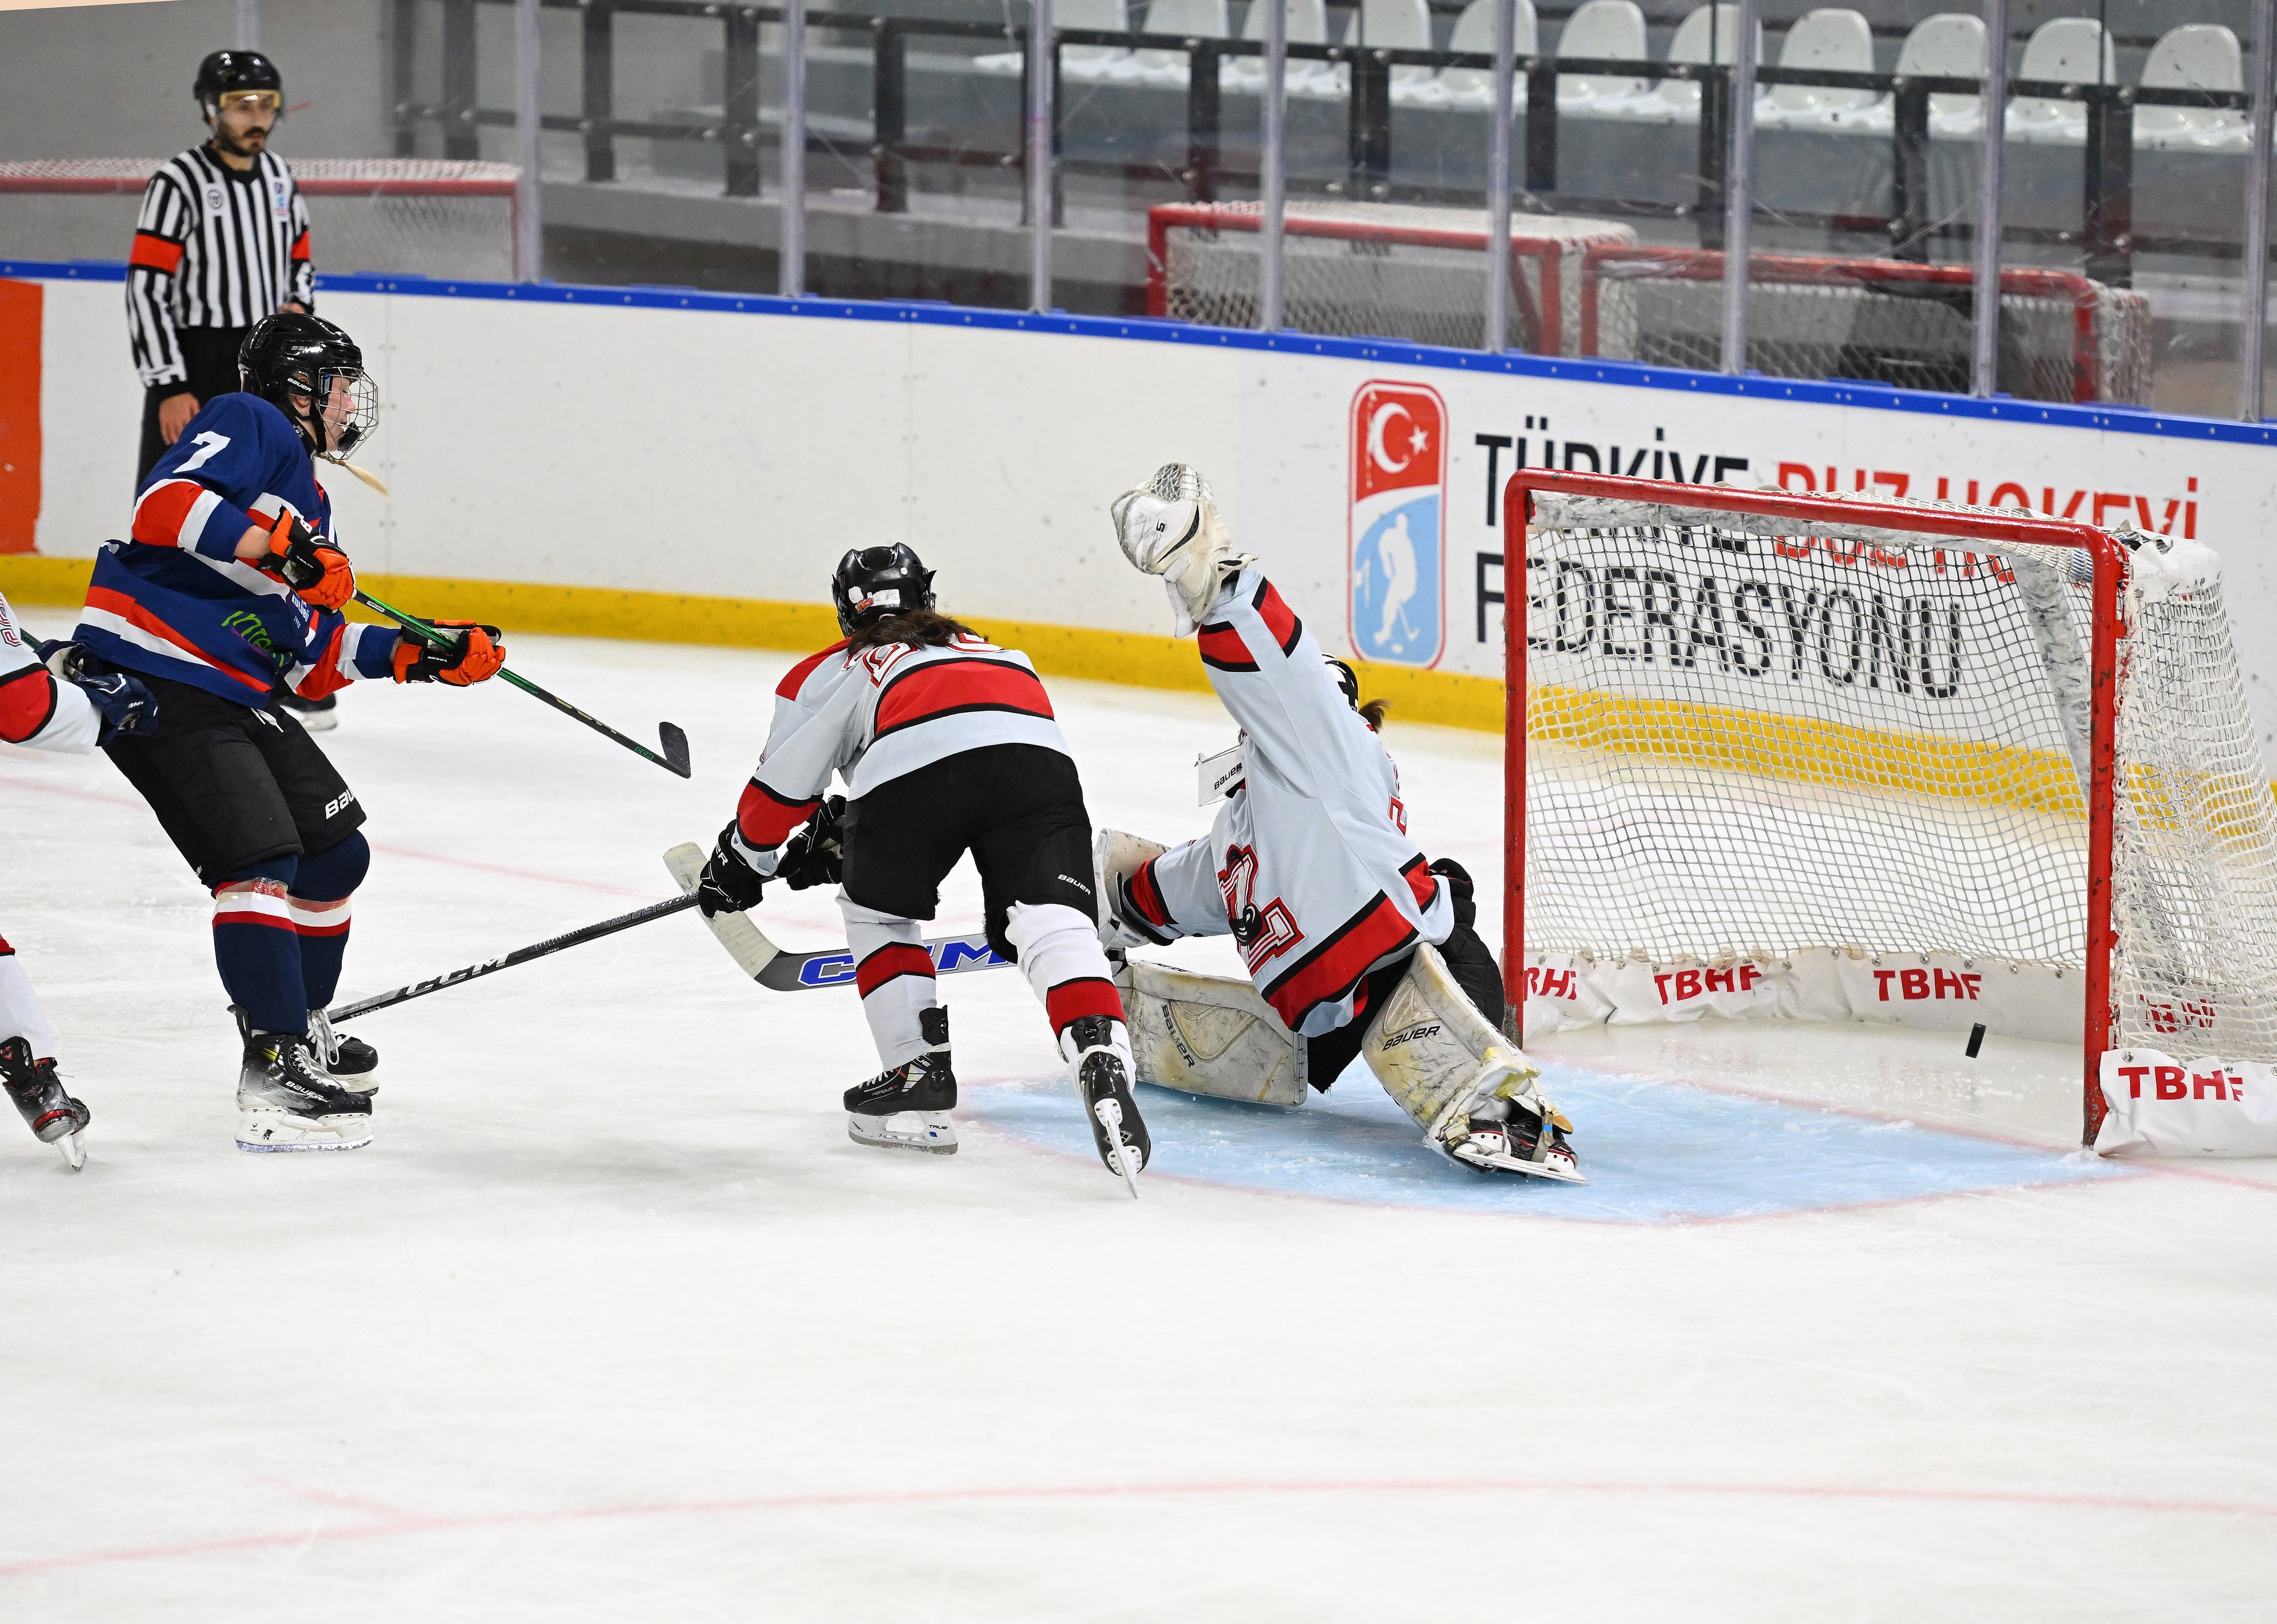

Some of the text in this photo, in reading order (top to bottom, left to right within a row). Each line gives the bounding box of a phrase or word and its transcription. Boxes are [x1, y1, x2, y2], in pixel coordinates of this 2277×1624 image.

[287, 377, 312, 392] BAUER
[172, 431, 231, 473] 7
[1214, 762, 1243, 791] BAUER
[1057, 873, 1091, 896] BAUER
[405, 953, 510, 996] CCM
[797, 940, 1009, 988] CM
[1654, 964, 1762, 1006] TBHF
[1873, 968, 1982, 1001] TBHF
[1162, 1004, 1195, 1069] BAUER
[1382, 1025, 1441, 1052] BAUER
[2117, 1066, 2244, 1103] TBHF
